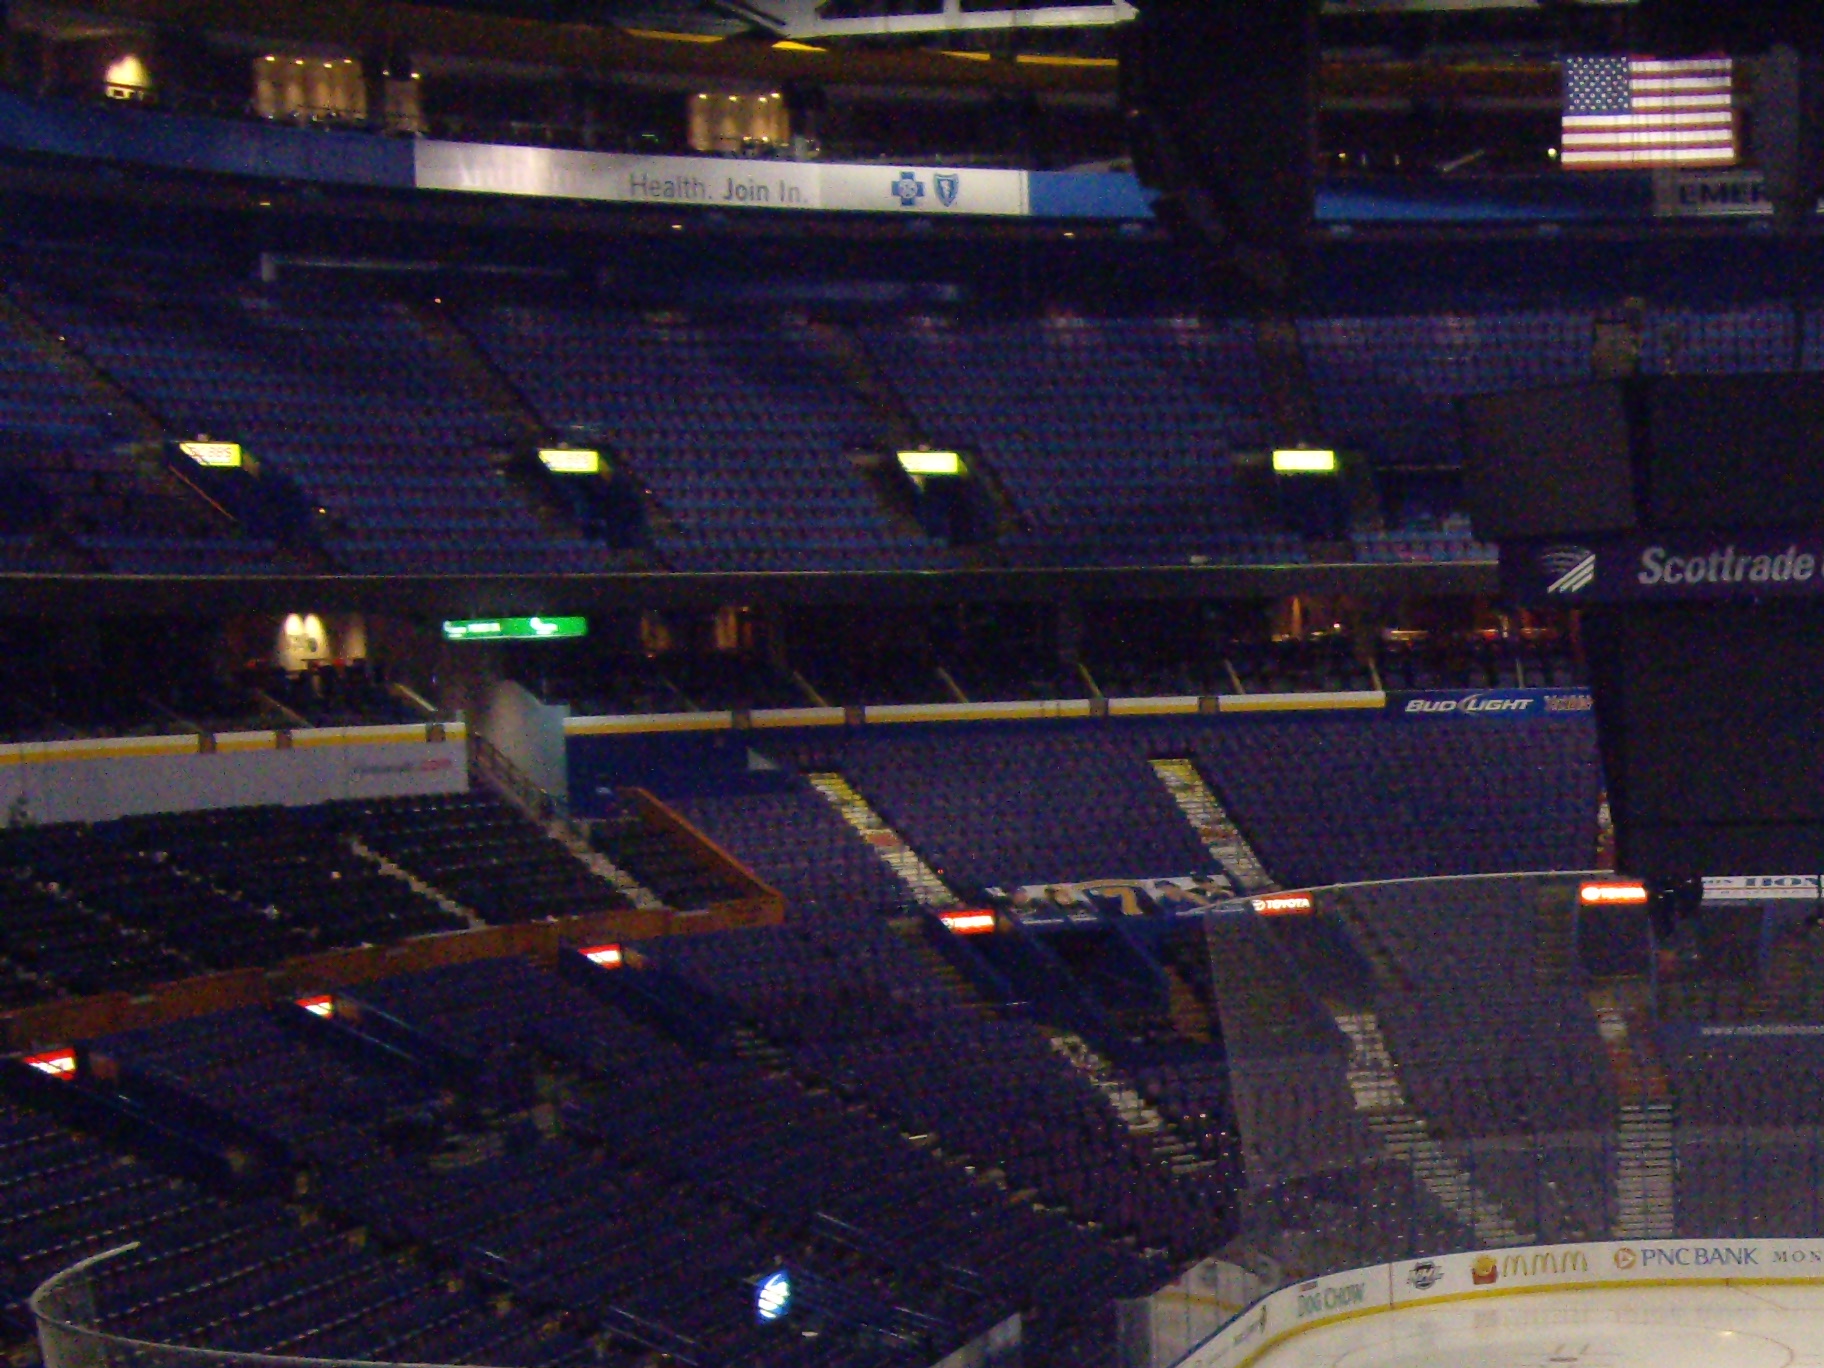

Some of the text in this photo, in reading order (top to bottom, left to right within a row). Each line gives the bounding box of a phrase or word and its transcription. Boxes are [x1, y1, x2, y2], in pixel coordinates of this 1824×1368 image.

[629, 173, 808, 204] Health. Join In.
[1638, 546, 1815, 585] Scottrade
[1405, 699, 1458, 712] BUD
[1466, 698, 1534, 712] LIGHT
[1266, 899, 1310, 909] TOYOTA
